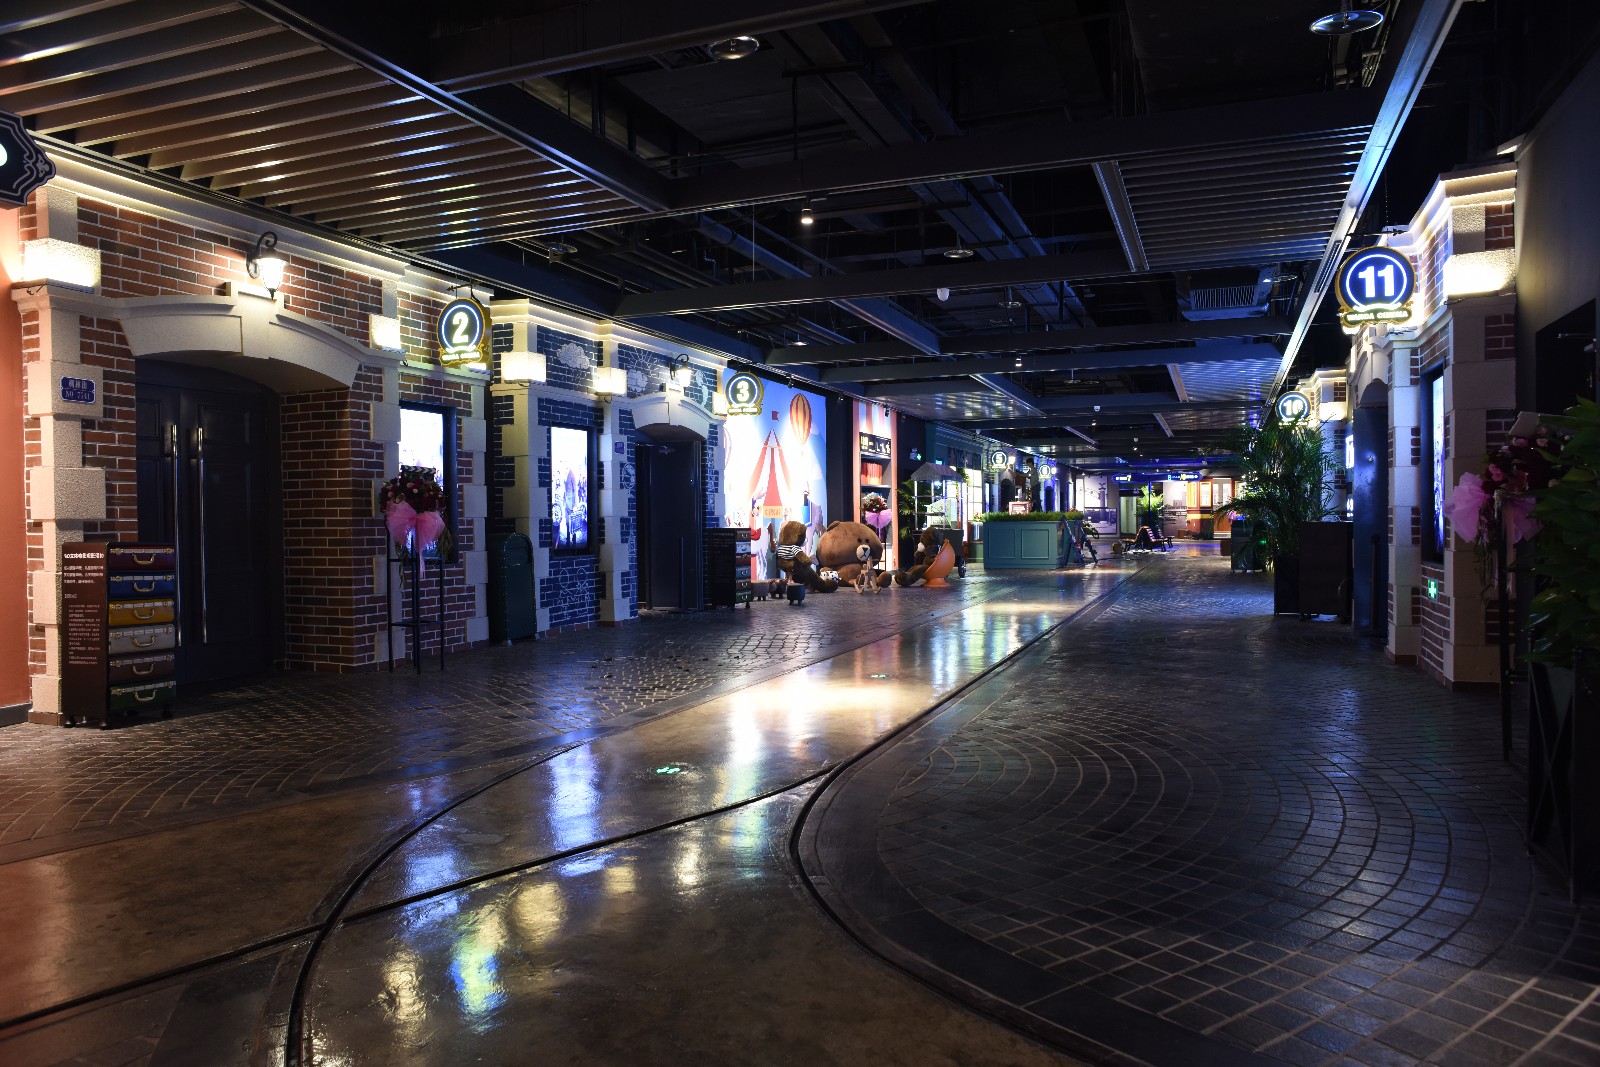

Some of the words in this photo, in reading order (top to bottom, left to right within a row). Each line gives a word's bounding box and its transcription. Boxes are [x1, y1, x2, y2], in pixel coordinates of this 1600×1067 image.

[1358, 264, 1395, 298] 11
[453, 311, 469, 343] 2
[737, 380, 750, 402] 3
[1283, 399, 1304, 415] 10
[996, 454, 1003, 463] 5
